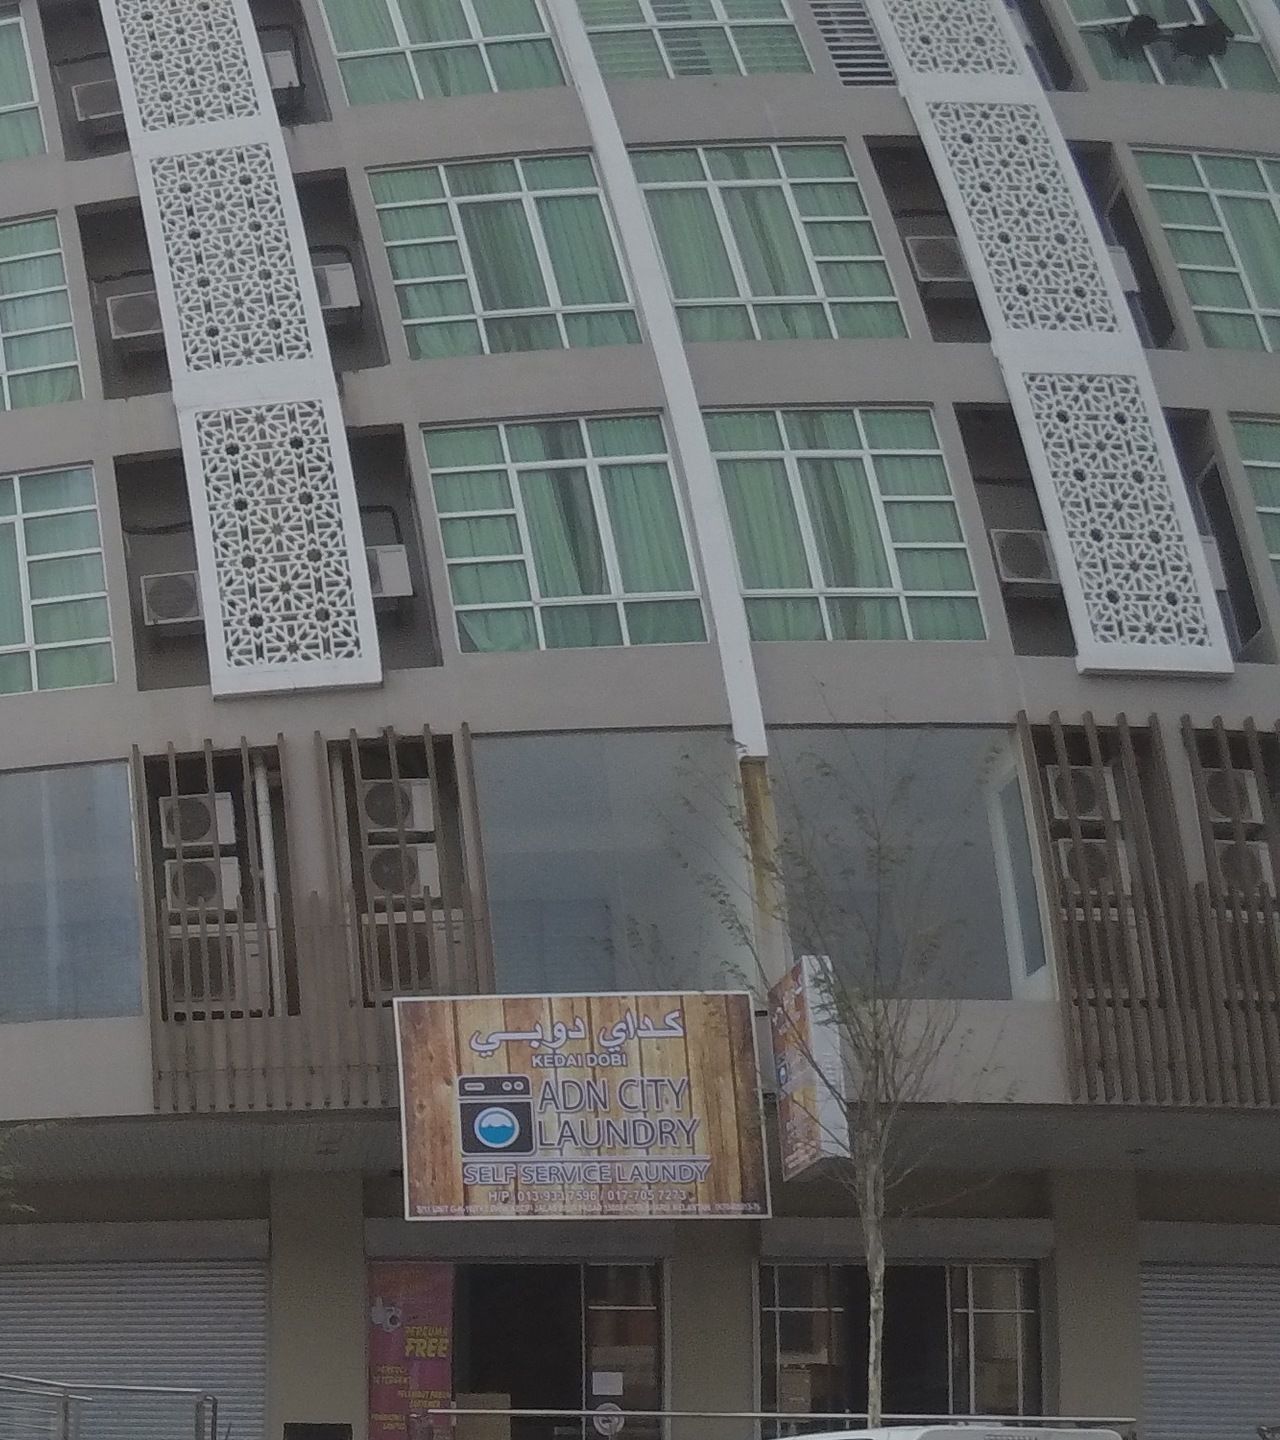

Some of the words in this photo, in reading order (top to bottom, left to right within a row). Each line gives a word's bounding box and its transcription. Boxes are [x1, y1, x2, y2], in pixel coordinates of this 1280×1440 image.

[531, 1053, 583, 1068] KEDAI
[586, 1053, 627, 1067] DOBI
[538, 1077, 610, 1112] ADN
[617, 1076, 689, 1112] CITY
[538, 1117, 700, 1149] LAUNDRY
[463, 1162, 517, 1185] SELF
[520, 1162, 612, 1185] SERVICE
[615, 1160, 711, 1184] LAUNDY
[405, 1338, 448, 1357] FREE
